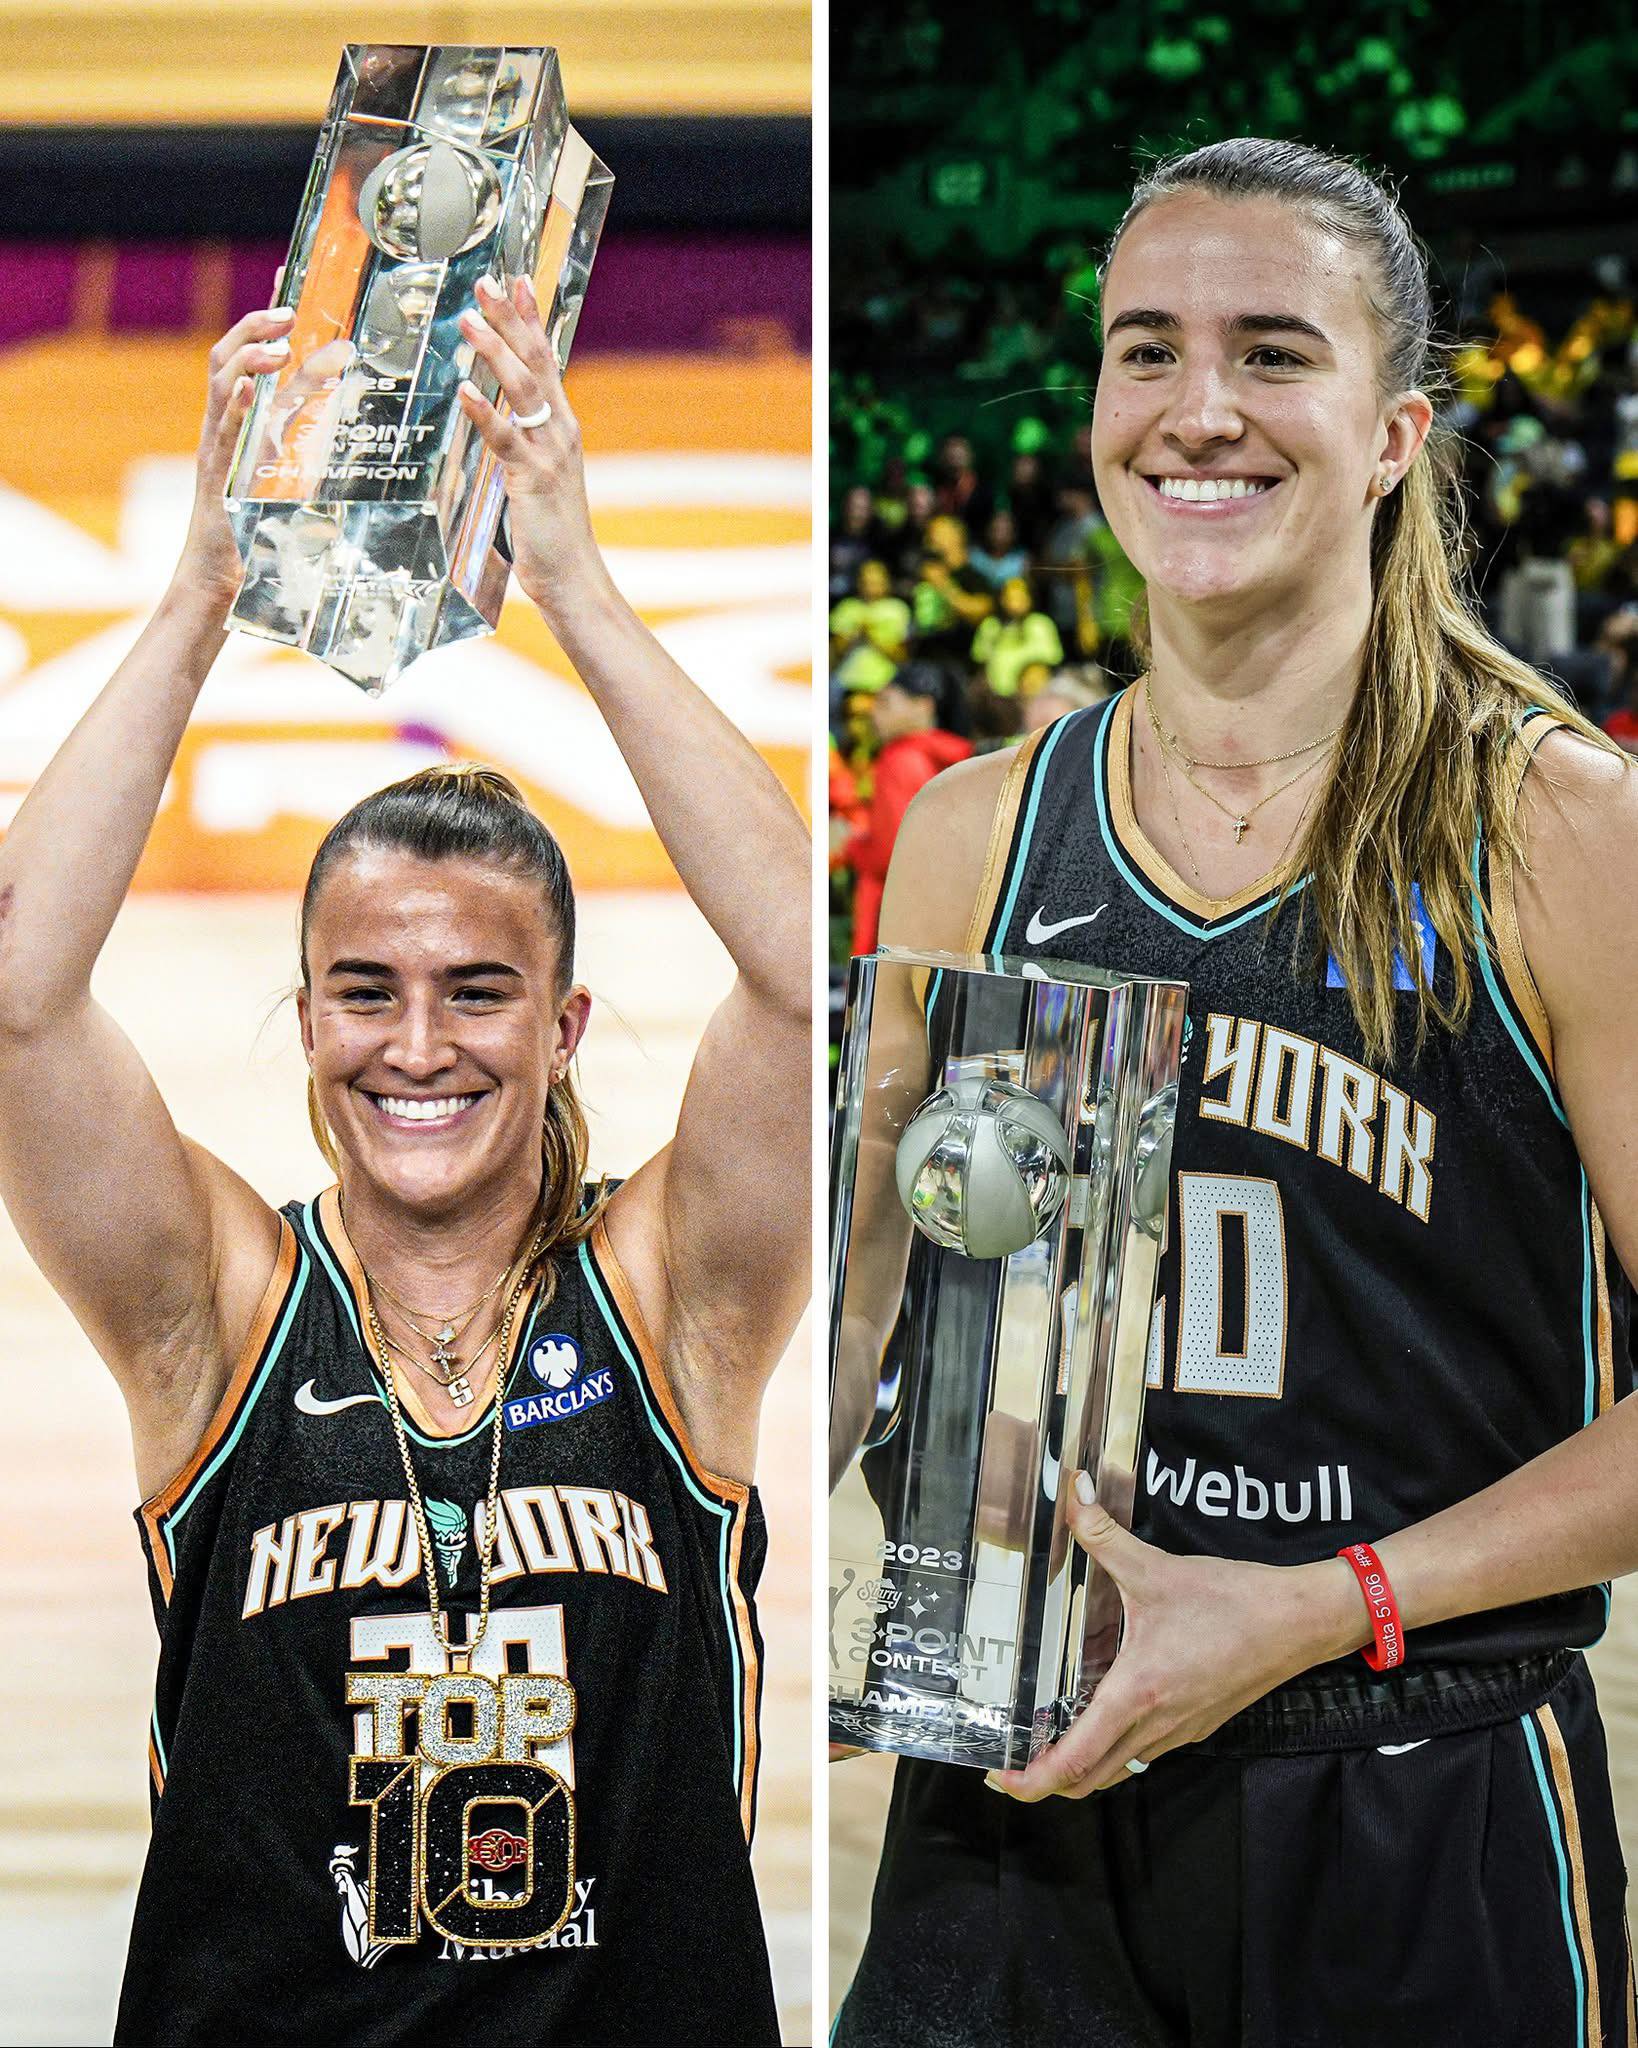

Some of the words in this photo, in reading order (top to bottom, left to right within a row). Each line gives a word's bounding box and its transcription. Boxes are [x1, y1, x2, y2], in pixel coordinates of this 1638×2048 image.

[322, 377, 397, 392] 225
[255, 464, 419, 481] CHMPION
[1199, 1012, 1437, 1223] YORK
[508, 1370, 615, 1428] BARCLAYS
[1146, 1447, 1352, 1523] Webull
[242, 1499, 421, 1620] NEW
[474, 1485, 669, 1595] YORK
[876, 1540, 963, 1571] 2023
[857, 1579, 903, 1610] Starry
[1365, 1573, 1392, 1619] 5106
[848, 1646, 988, 1682] CONTEST
[345, 1672, 577, 1766] TOP
[348, 1755, 577, 1949] 10
